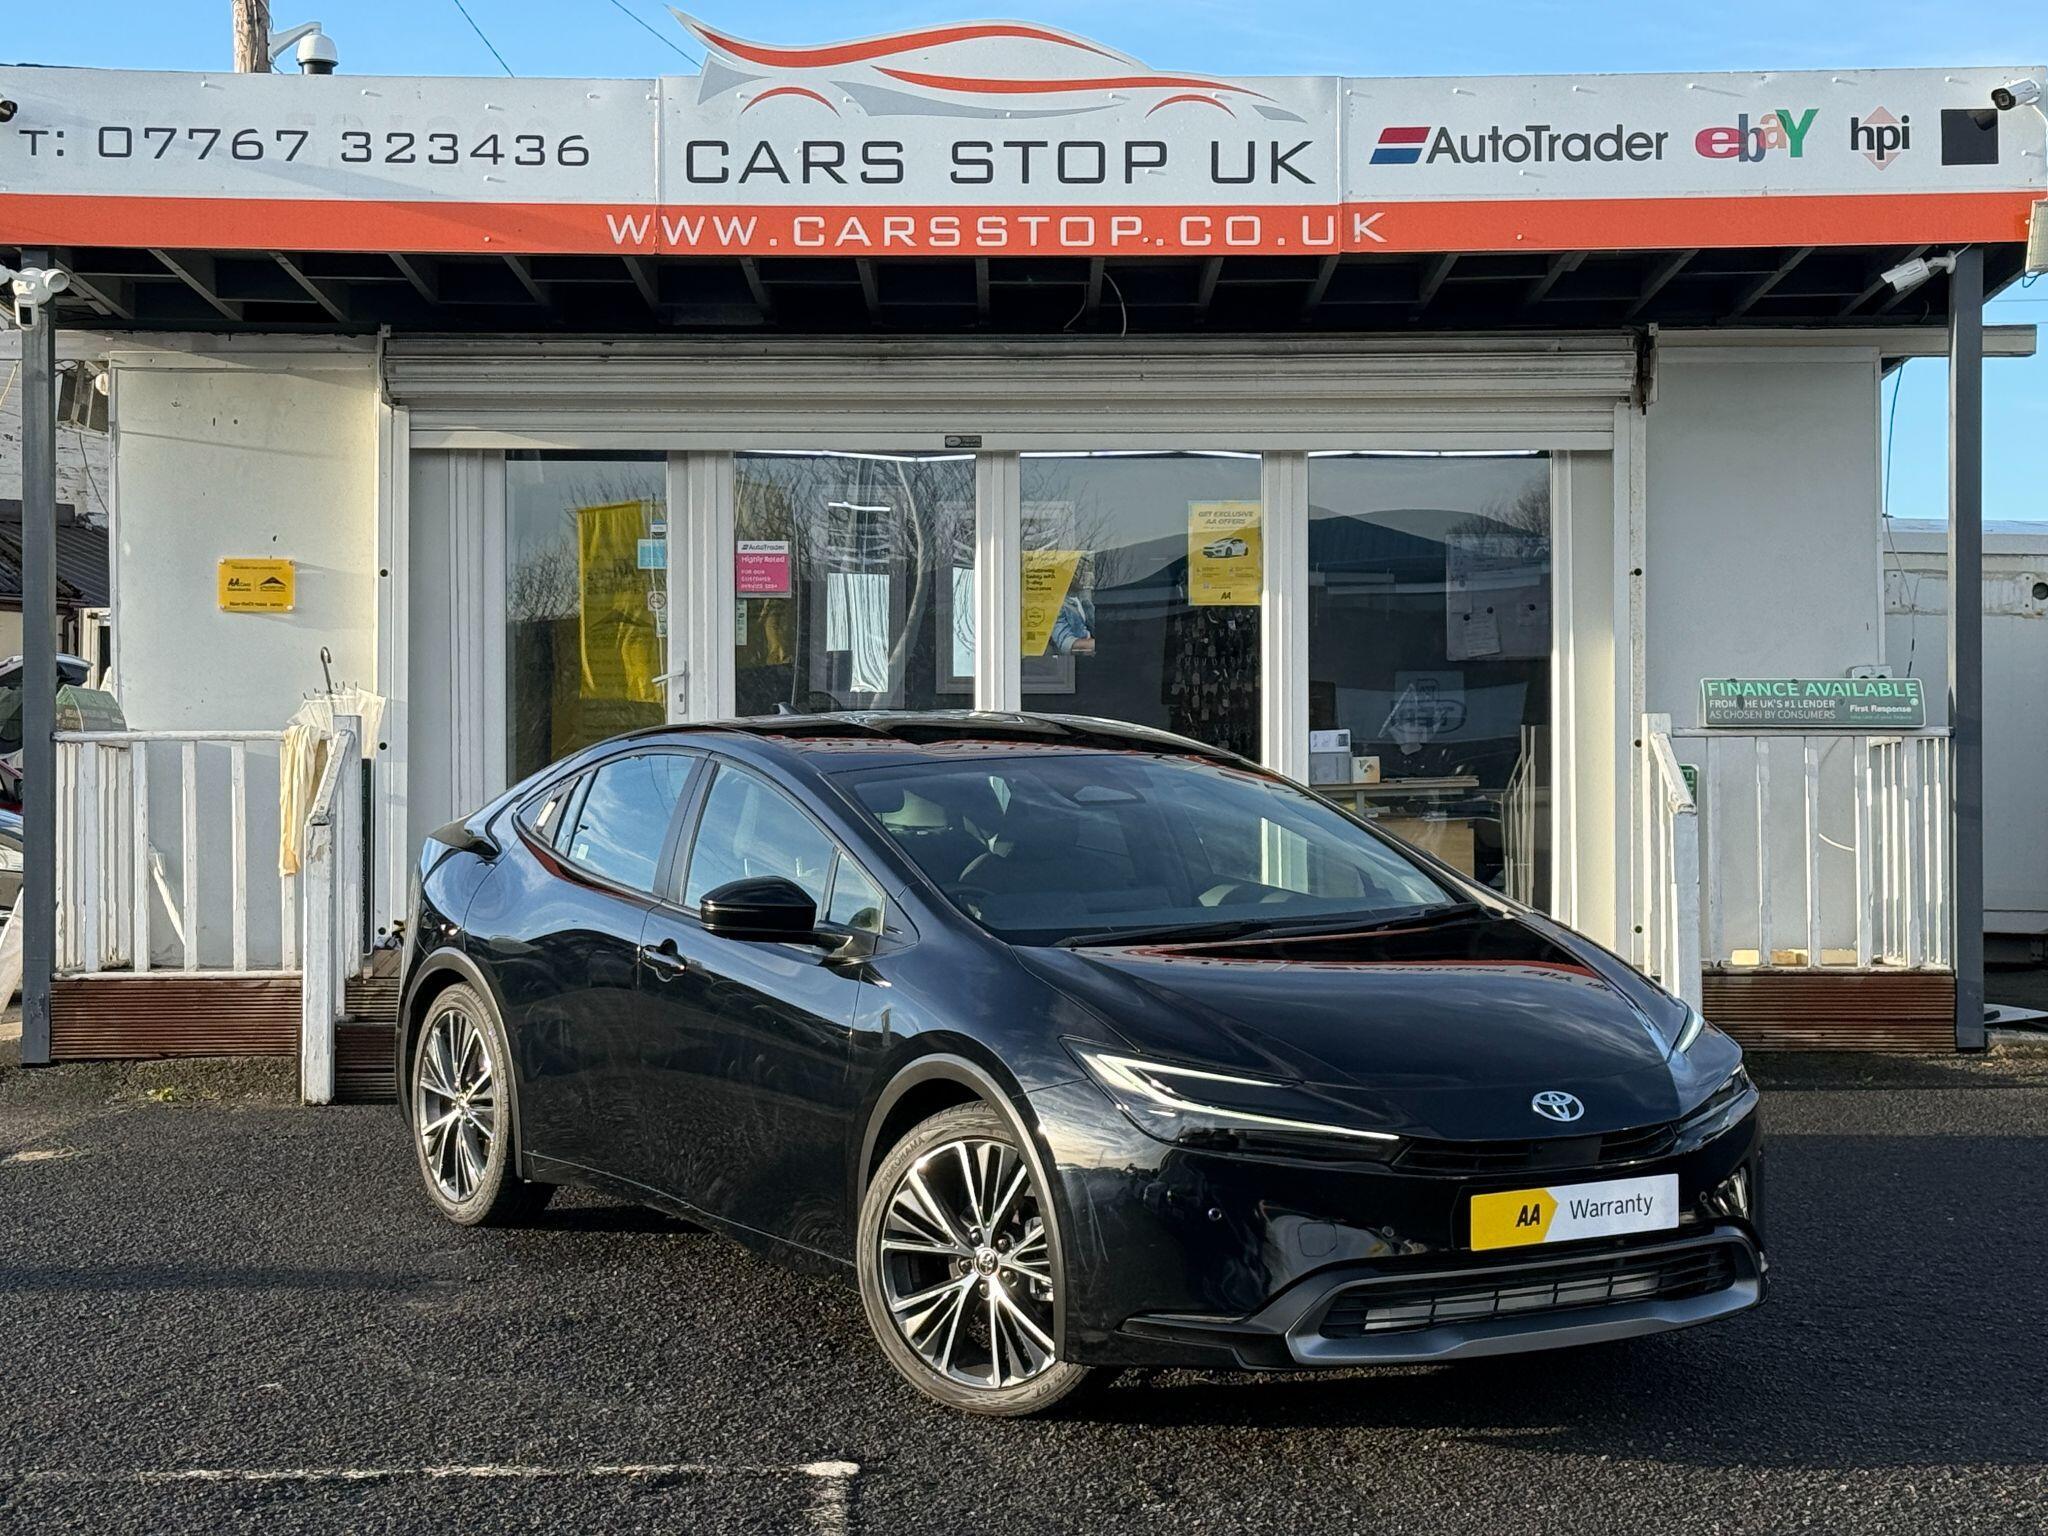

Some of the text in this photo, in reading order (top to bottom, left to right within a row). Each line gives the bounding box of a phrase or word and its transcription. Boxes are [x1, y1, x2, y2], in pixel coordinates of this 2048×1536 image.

[19, 125, 590, 168] T: 07767 323436
[1426, 122, 1668, 164] AutoTrader
[1850, 115, 1911, 167] hpi
[685, 139, 1316, 185] CARS STOP UK
[605, 211, 1387, 248] WWW.CARSSTOP.CO.UK
[1220, 591, 1232, 600] AA
[1707, 681, 1919, 698] FINANCE AVAILABLE
[1709, 699, 1737, 709] FROM
[1760, 699, 1783, 709] UK'S
[1798, 699, 1836, 709] LENDER
[1709, 709, 1836, 720] AS CHOSEN BY CONSUMERS
[1849, 704, 1912, 714] First Response
[1515, 1193, 1654, 1228] AA Warranty
